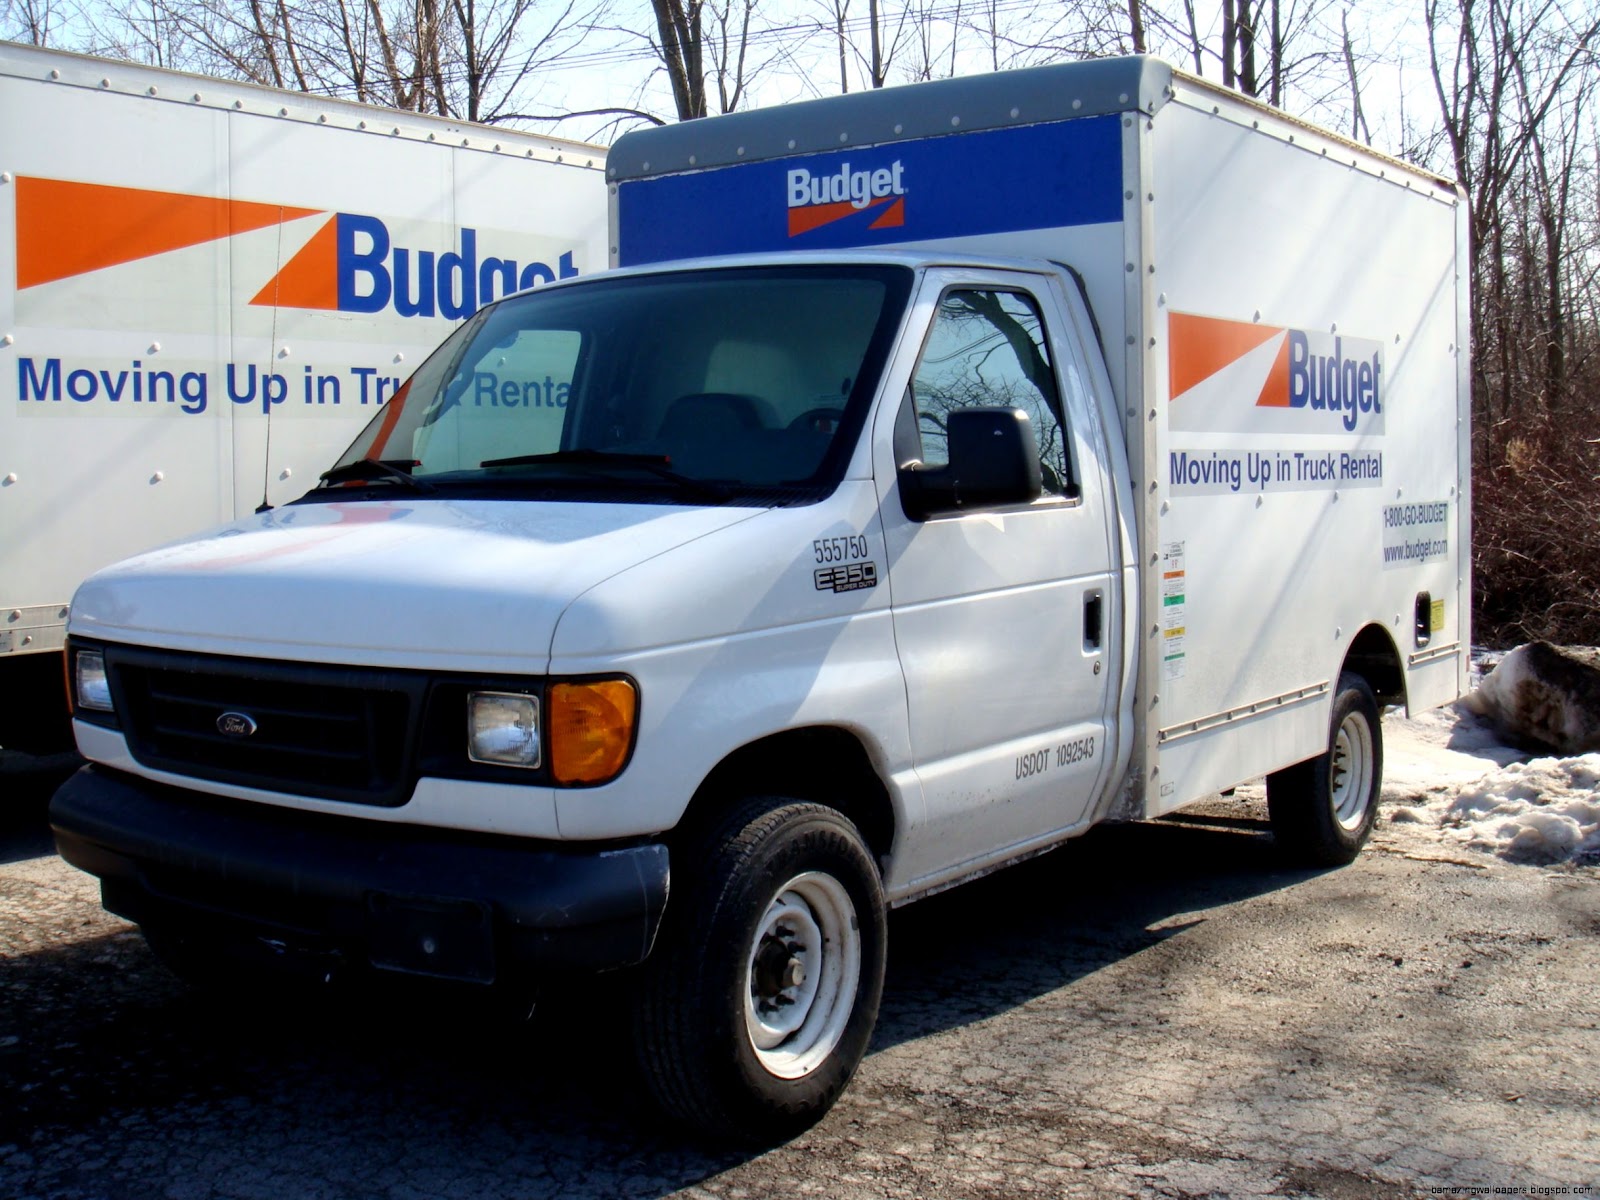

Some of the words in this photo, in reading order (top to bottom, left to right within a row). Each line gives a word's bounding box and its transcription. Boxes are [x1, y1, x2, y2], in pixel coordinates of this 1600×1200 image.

[788, 160, 905, 209] Budget
[18, 358, 208, 414] Moving
[227, 363, 288, 414] Up
[305, 365, 341, 404] in
[1289, 328, 1381, 432] Budget
[1170, 452, 1241, 492] Moving
[1248, 452, 1271, 490] Up
[1277, 452, 1291, 482] in
[1294, 452, 1336, 481] Truck
[1340, 453, 1382, 480] Rental
[1384, 503, 1448, 528] 1-800-GO-BUDGET
[813, 534, 868, 564] 555750
[1384, 538, 1448, 563] www.budget.com
[224, 717, 246, 733] Ford
[1015, 748, 1050, 780] USDOT
[1056, 736, 1095, 768] 1092543
